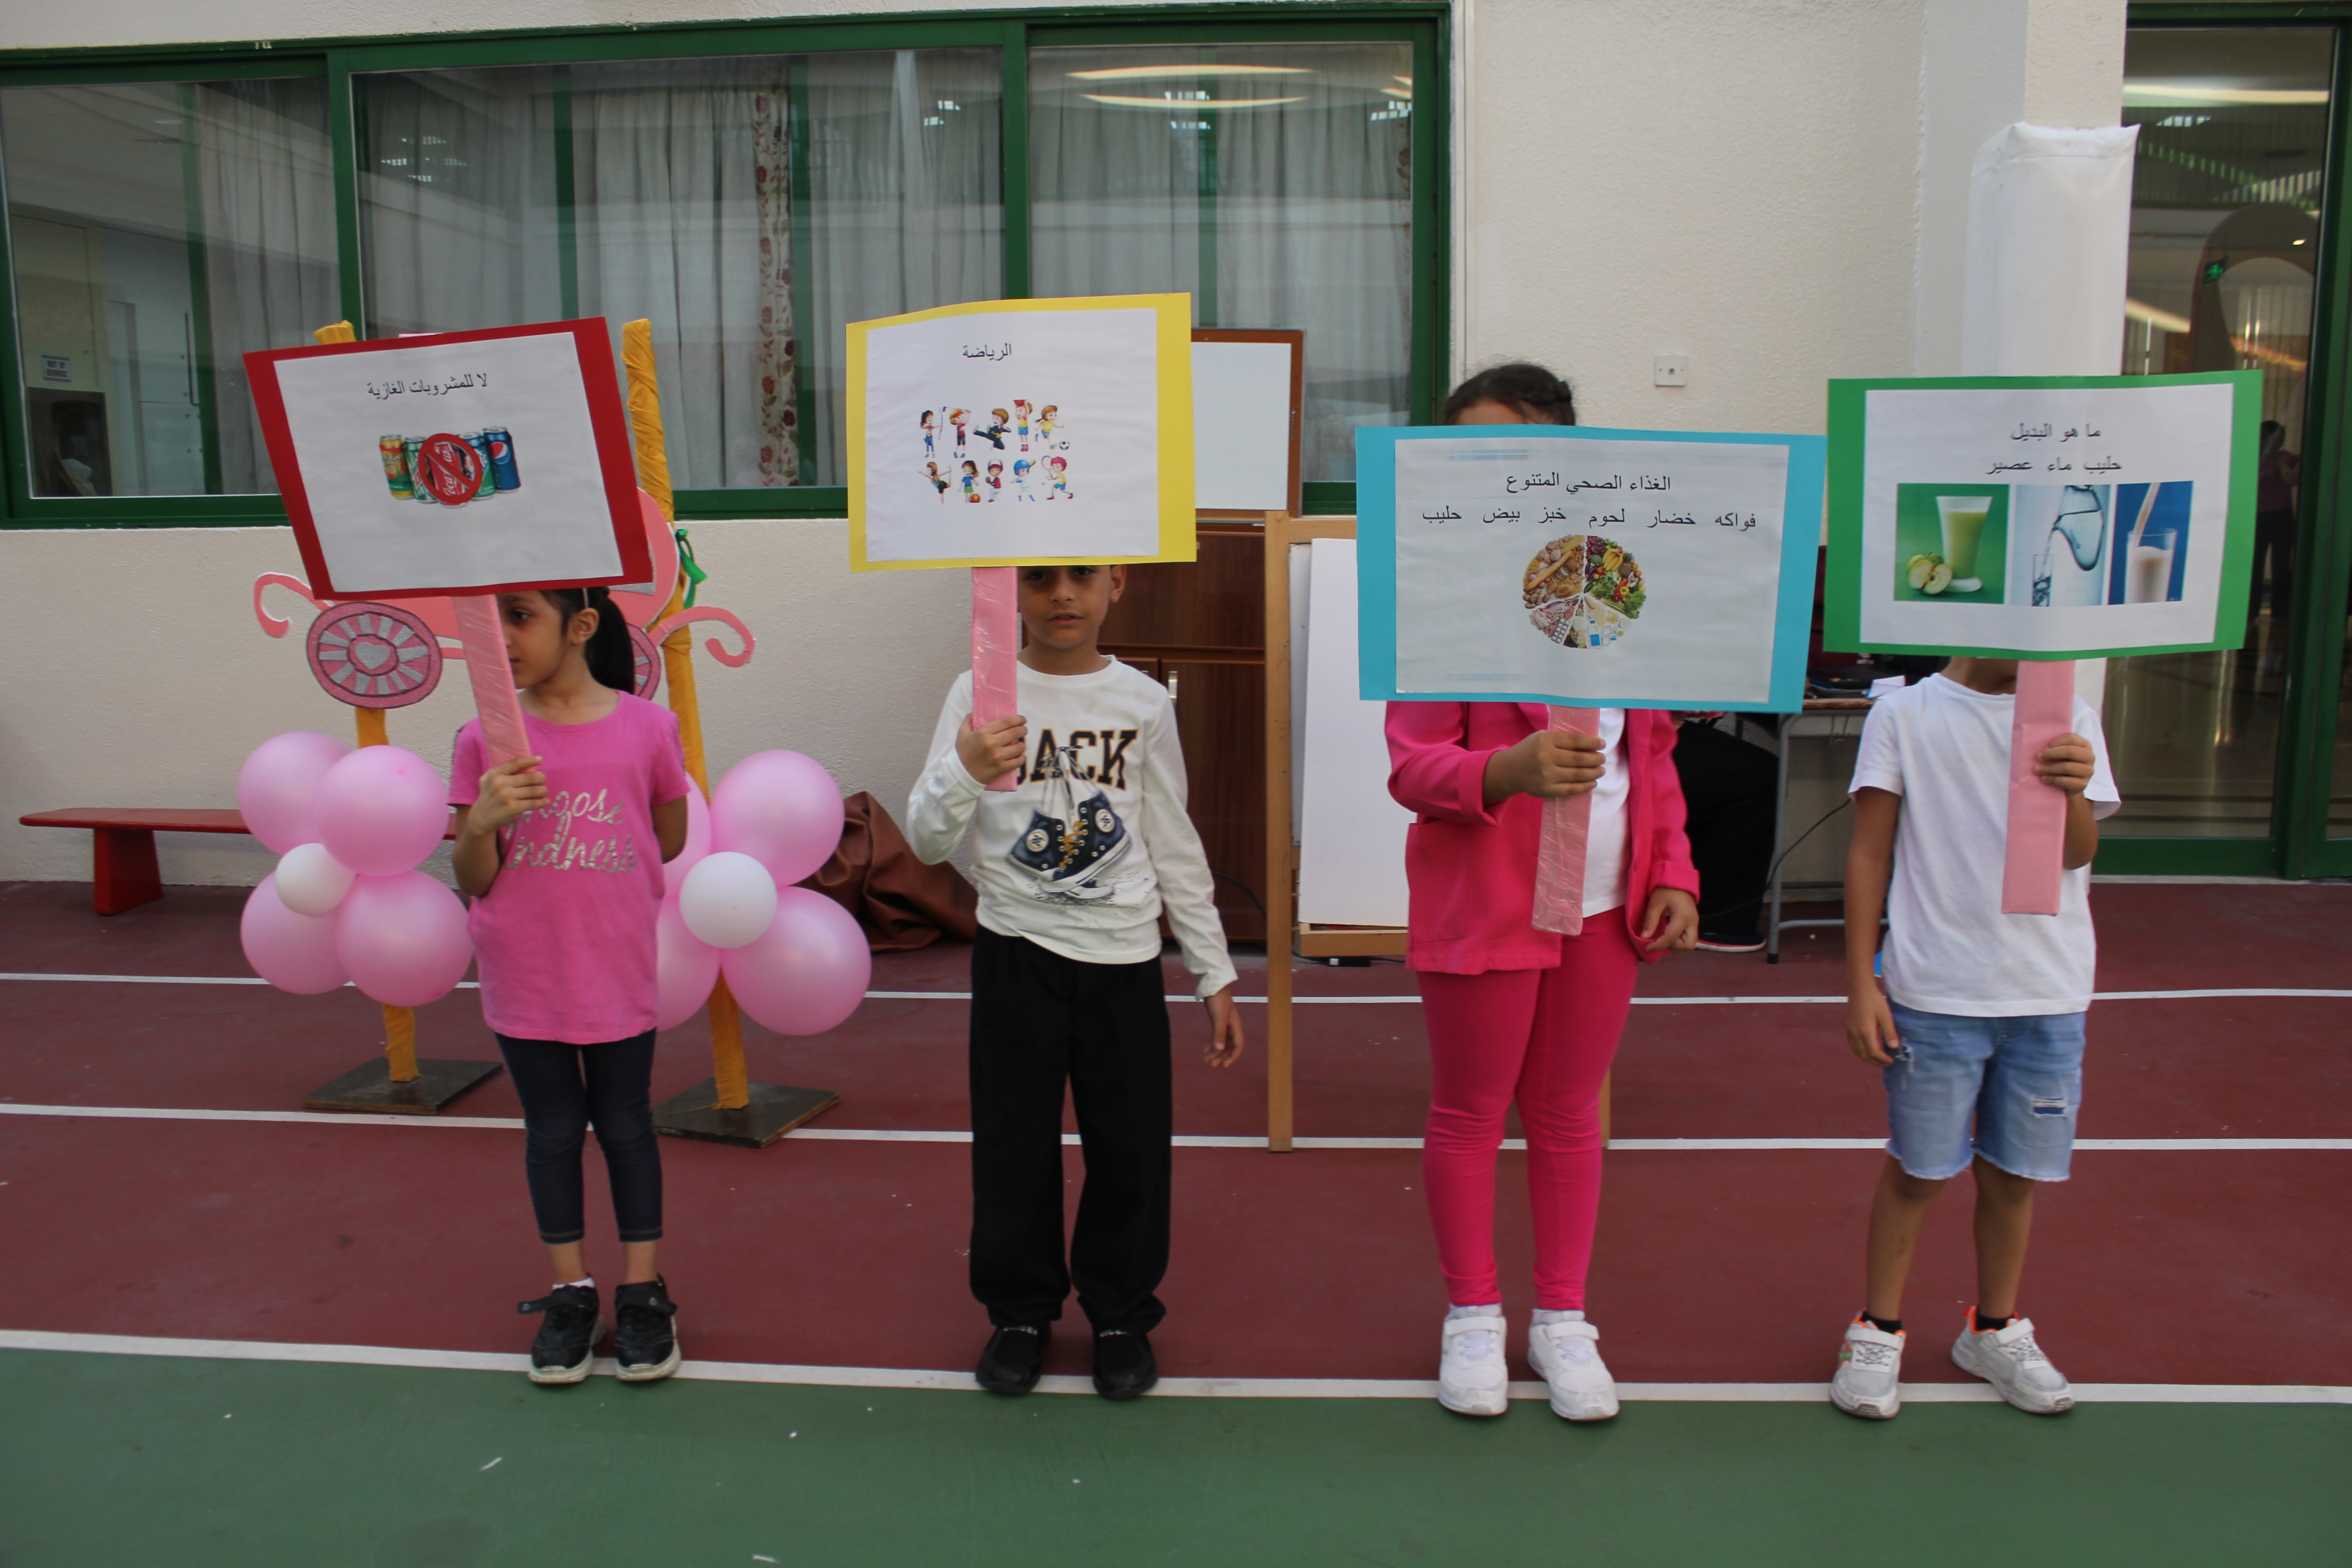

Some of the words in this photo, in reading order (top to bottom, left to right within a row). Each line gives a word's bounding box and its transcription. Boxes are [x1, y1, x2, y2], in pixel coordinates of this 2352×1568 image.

[963, 343, 1012, 361] الرياضة
[410, 373, 474, 396] للمشروبات
[476, 372, 487, 387] لا
[367, 380, 405, 400] الغازية
[2010, 422, 2052, 441] البديل
[2058, 427, 2079, 442] هو
[2086, 423, 2101, 436] ما
[1985, 461, 2033, 475] عصير
[2047, 456, 2072, 472] ماء
[2083, 455, 2122, 474] حليب
[1506, 471, 1559, 493] المتنوع
[1566, 475, 1622, 495] الصحي
[1630, 475, 1671, 491] الغذاء
[1422, 505, 1462, 524] حليب
[1483, 508, 1520, 523] بيض
[1538, 507, 1566, 524] خبز
[1588, 508, 1625, 529] لحوم
[1646, 510, 1696, 528] خضار
[1715, 512, 1756, 531] فواكه
[1018, 729, 1139, 791] ACK
[523, 789, 625, 825] oose
[504, 811, 637, 873] ndness
